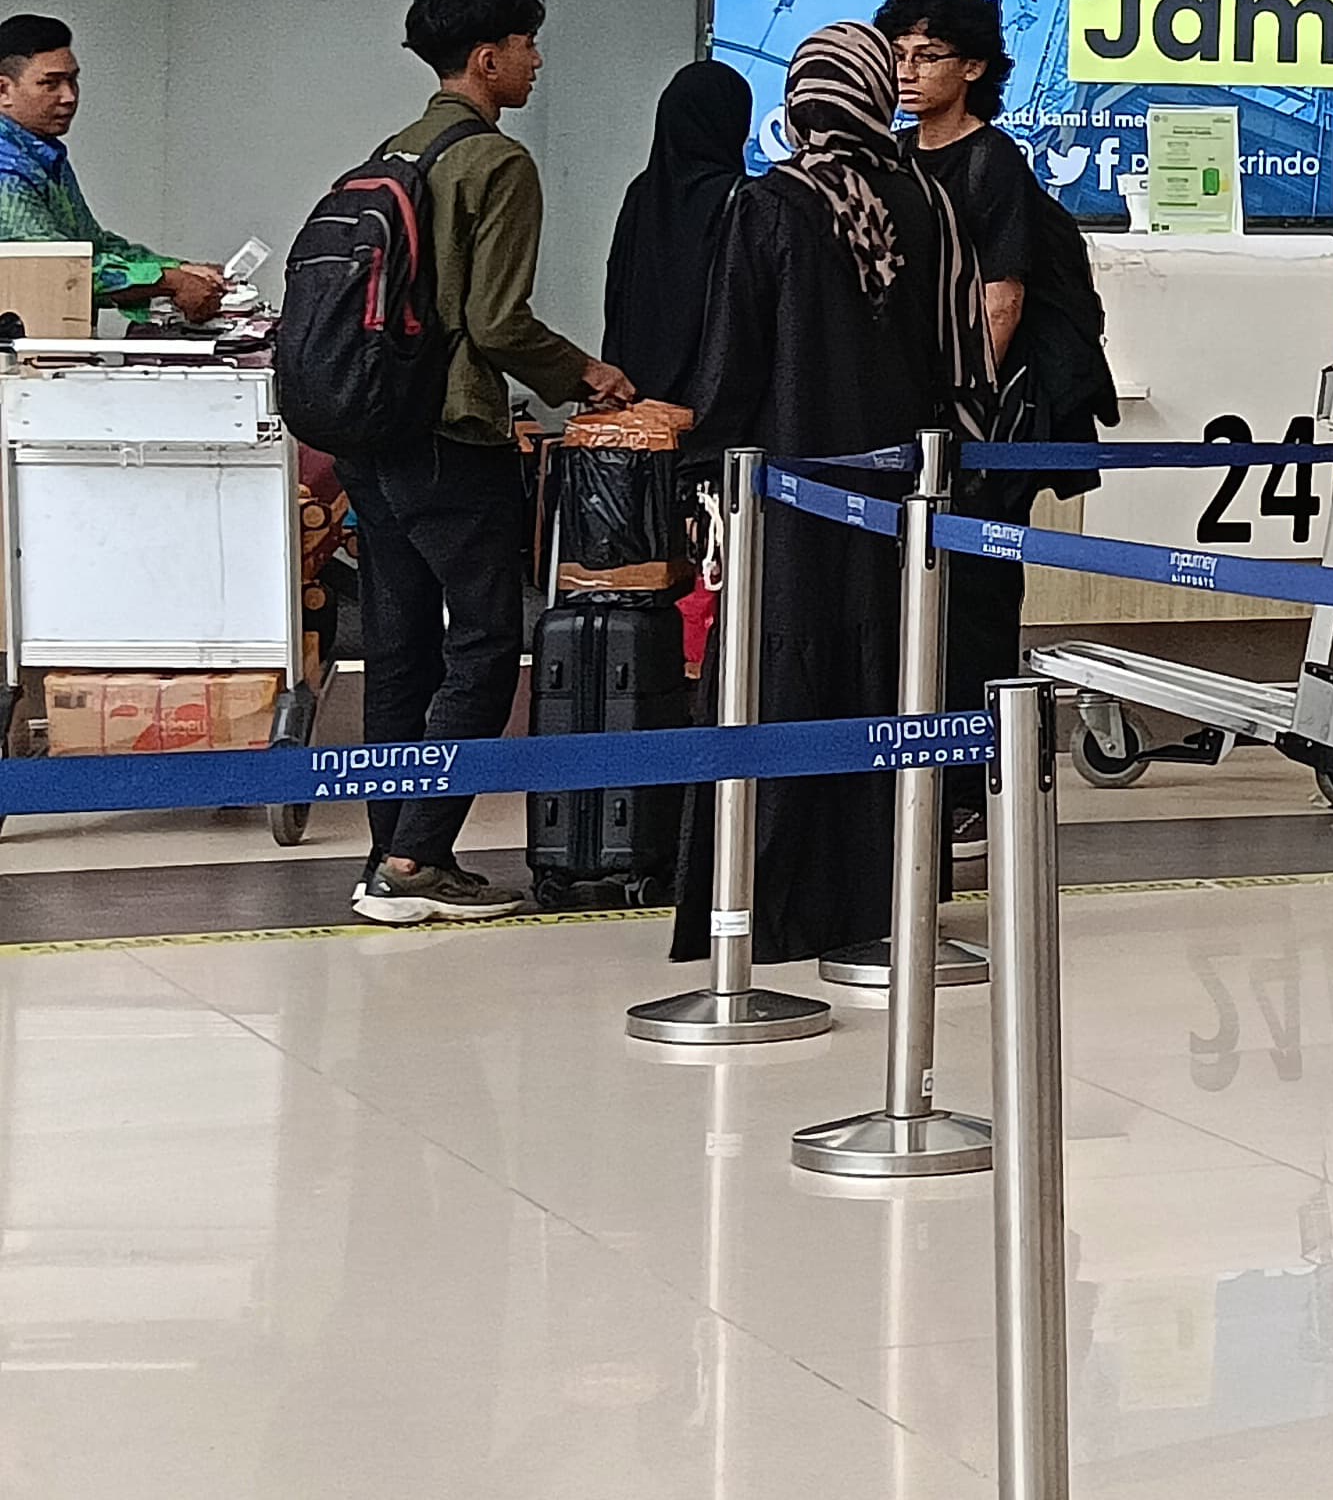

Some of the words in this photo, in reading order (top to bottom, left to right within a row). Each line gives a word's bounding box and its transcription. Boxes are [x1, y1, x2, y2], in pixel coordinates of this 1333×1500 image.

[1197, 414, 1320, 542] 24
[311, 744, 459, 779] injourney
[873, 746, 996, 768] AIRPORTS
[315, 776, 450, 797] AIRPORTS
